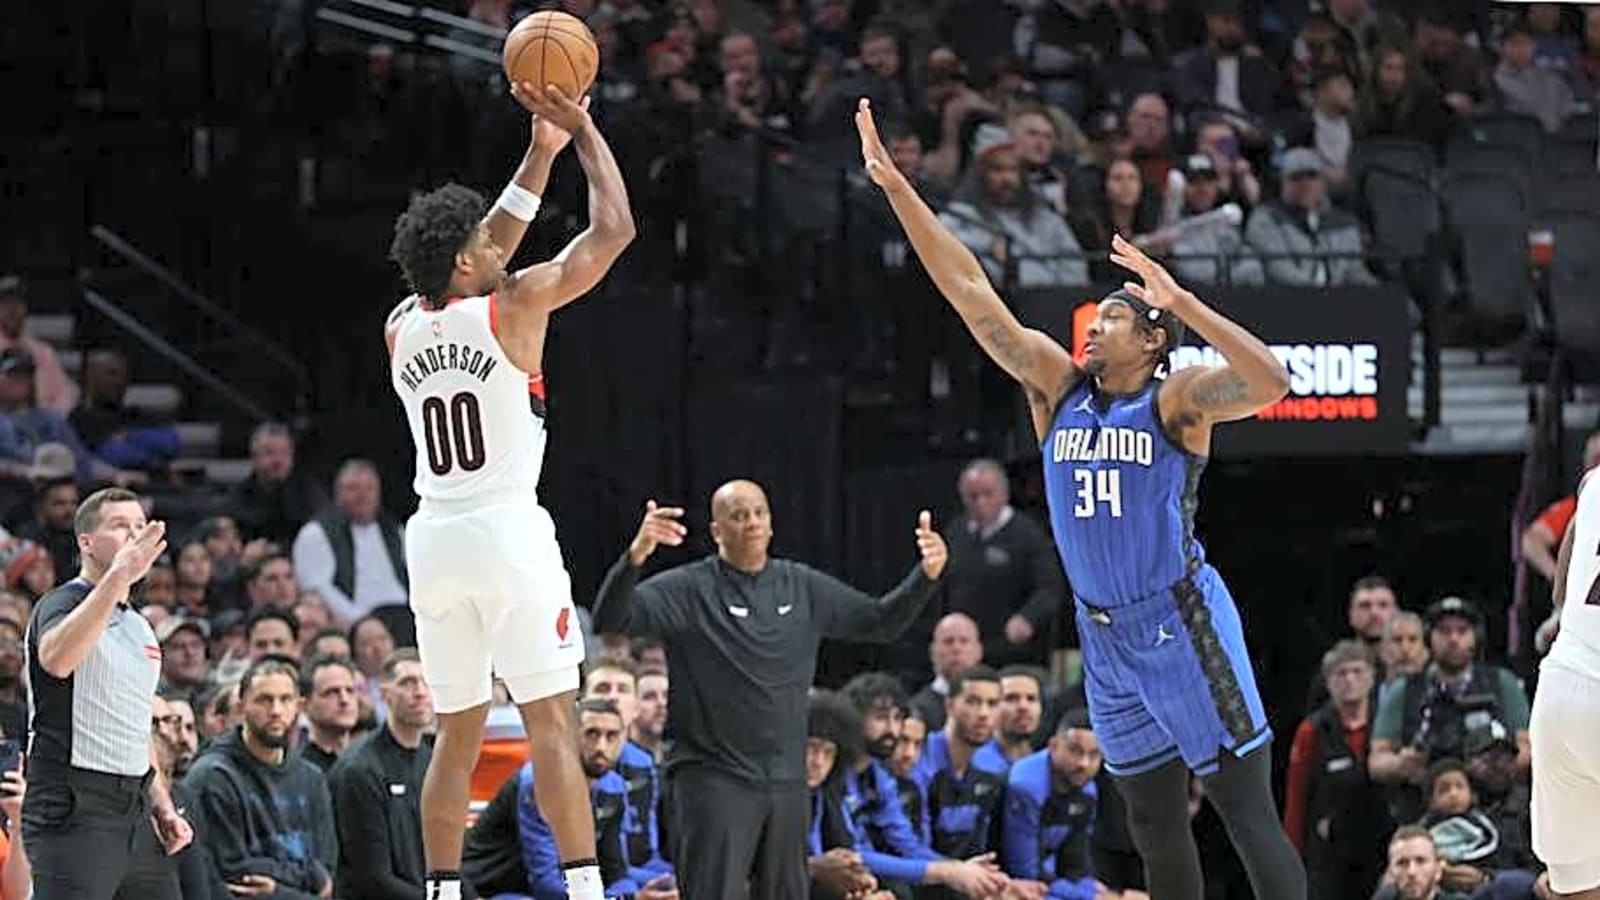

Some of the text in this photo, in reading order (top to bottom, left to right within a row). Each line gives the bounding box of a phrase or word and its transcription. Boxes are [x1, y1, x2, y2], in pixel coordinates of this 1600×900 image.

[400, 343, 498, 393] HENDERSON
[422, 391, 486, 476] 00
[1074, 469, 1121, 518] 34
